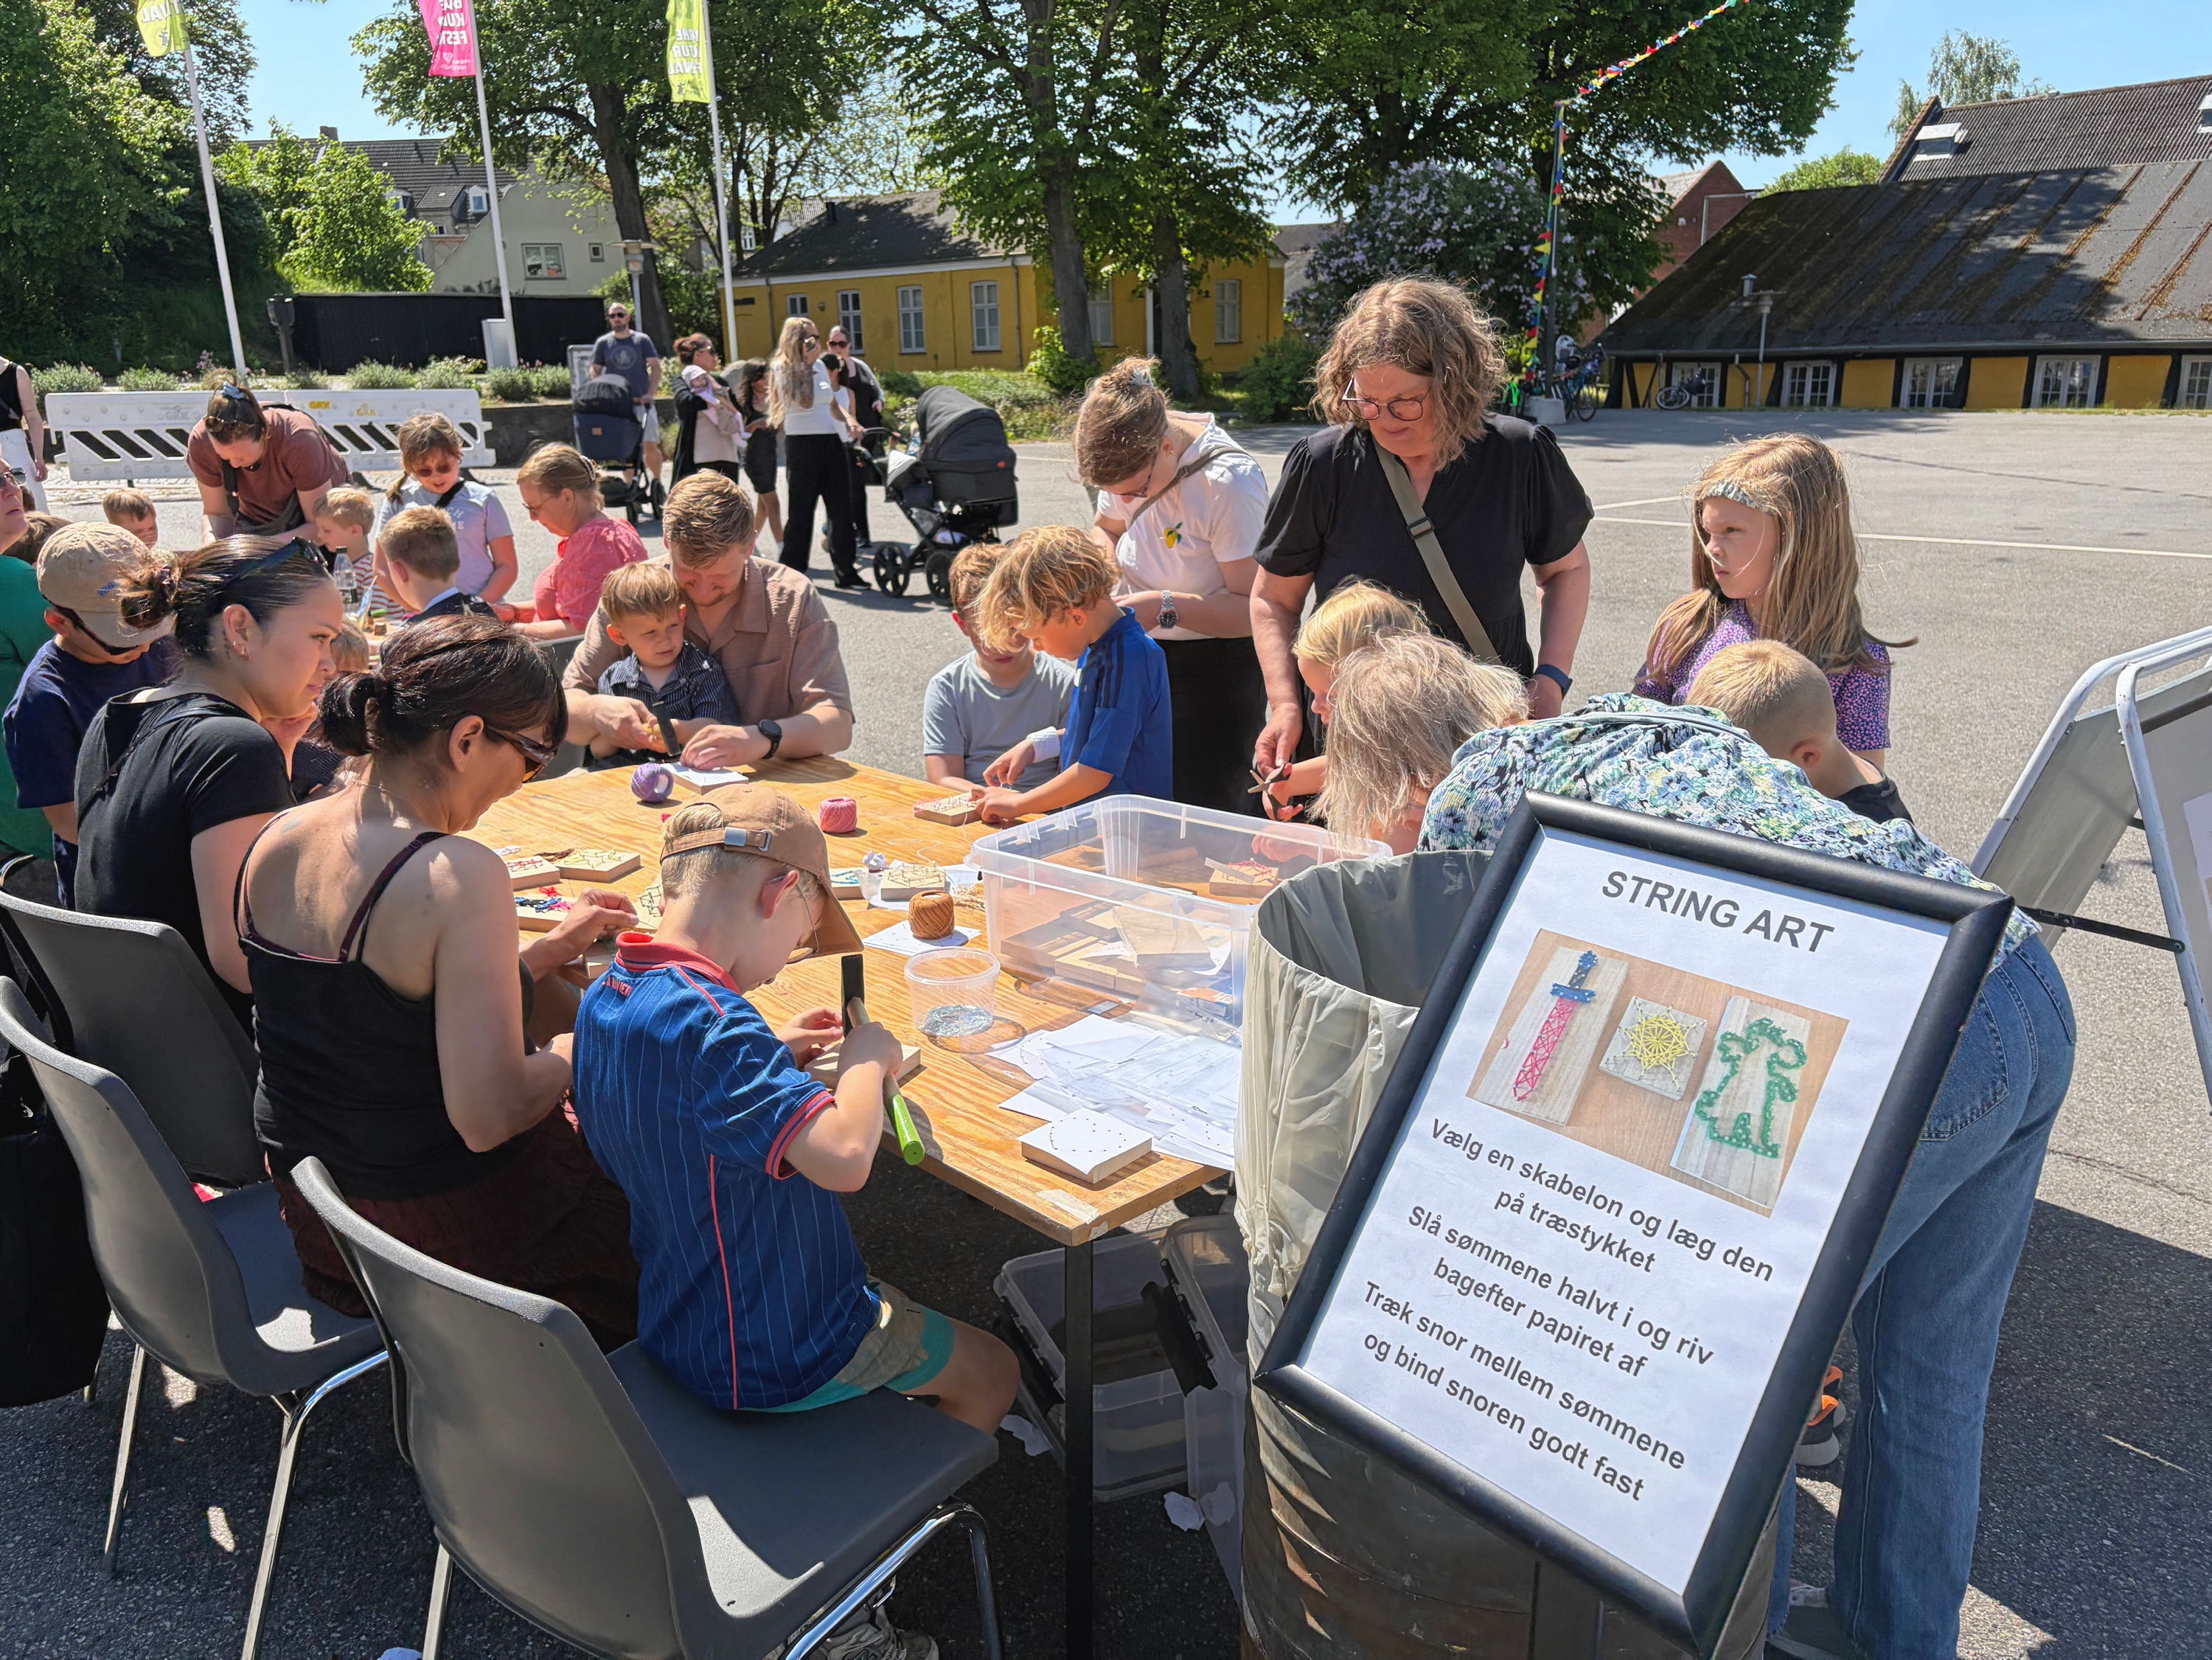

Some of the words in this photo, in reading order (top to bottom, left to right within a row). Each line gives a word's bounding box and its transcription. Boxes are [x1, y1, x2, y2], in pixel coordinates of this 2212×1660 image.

[1603, 872, 1739, 927] STRING
[1743, 910, 1834, 952] ART
[1433, 1119, 1483, 1160] Vælg
[1488, 1150, 1514, 1170] en
[1520, 1163, 1622, 1217] skabelon
[1630, 1210, 1661, 1237] og
[1667, 1220, 1716, 1260] læg
[1723, 1247, 1772, 1281] den
[1495, 1187, 1524, 1214] på
[1530, 1203, 1655, 1272] træstykket
[1409, 1206, 1441, 1236] Slå
[1445, 1229, 1551, 1288] sømmene
[1557, 1277, 1618, 1321] halvt
[1623, 1307, 1633, 1327] i
[1638, 1321, 1670, 1350] og
[1677, 1338, 1714, 1364] riv
[1434, 1257, 1526, 1316] bagefter
[1526, 1310, 1613, 1362] papiret
[1618, 1355, 1648, 1376] af
[1365, 1335, 1391, 1361] og
[1395, 1345, 1444, 1386] bind
[1447, 1380, 1525, 1434] snoren
[1529, 1428, 1588, 1469] godt
[1593, 1456, 1644, 1501] fast
[1366, 1281, 1413, 1324] Træk
[1417, 1317, 1467, 1350] snor
[1470, 1344, 1553, 1399] mellem
[1559, 1392, 1684, 1468] sømmene
